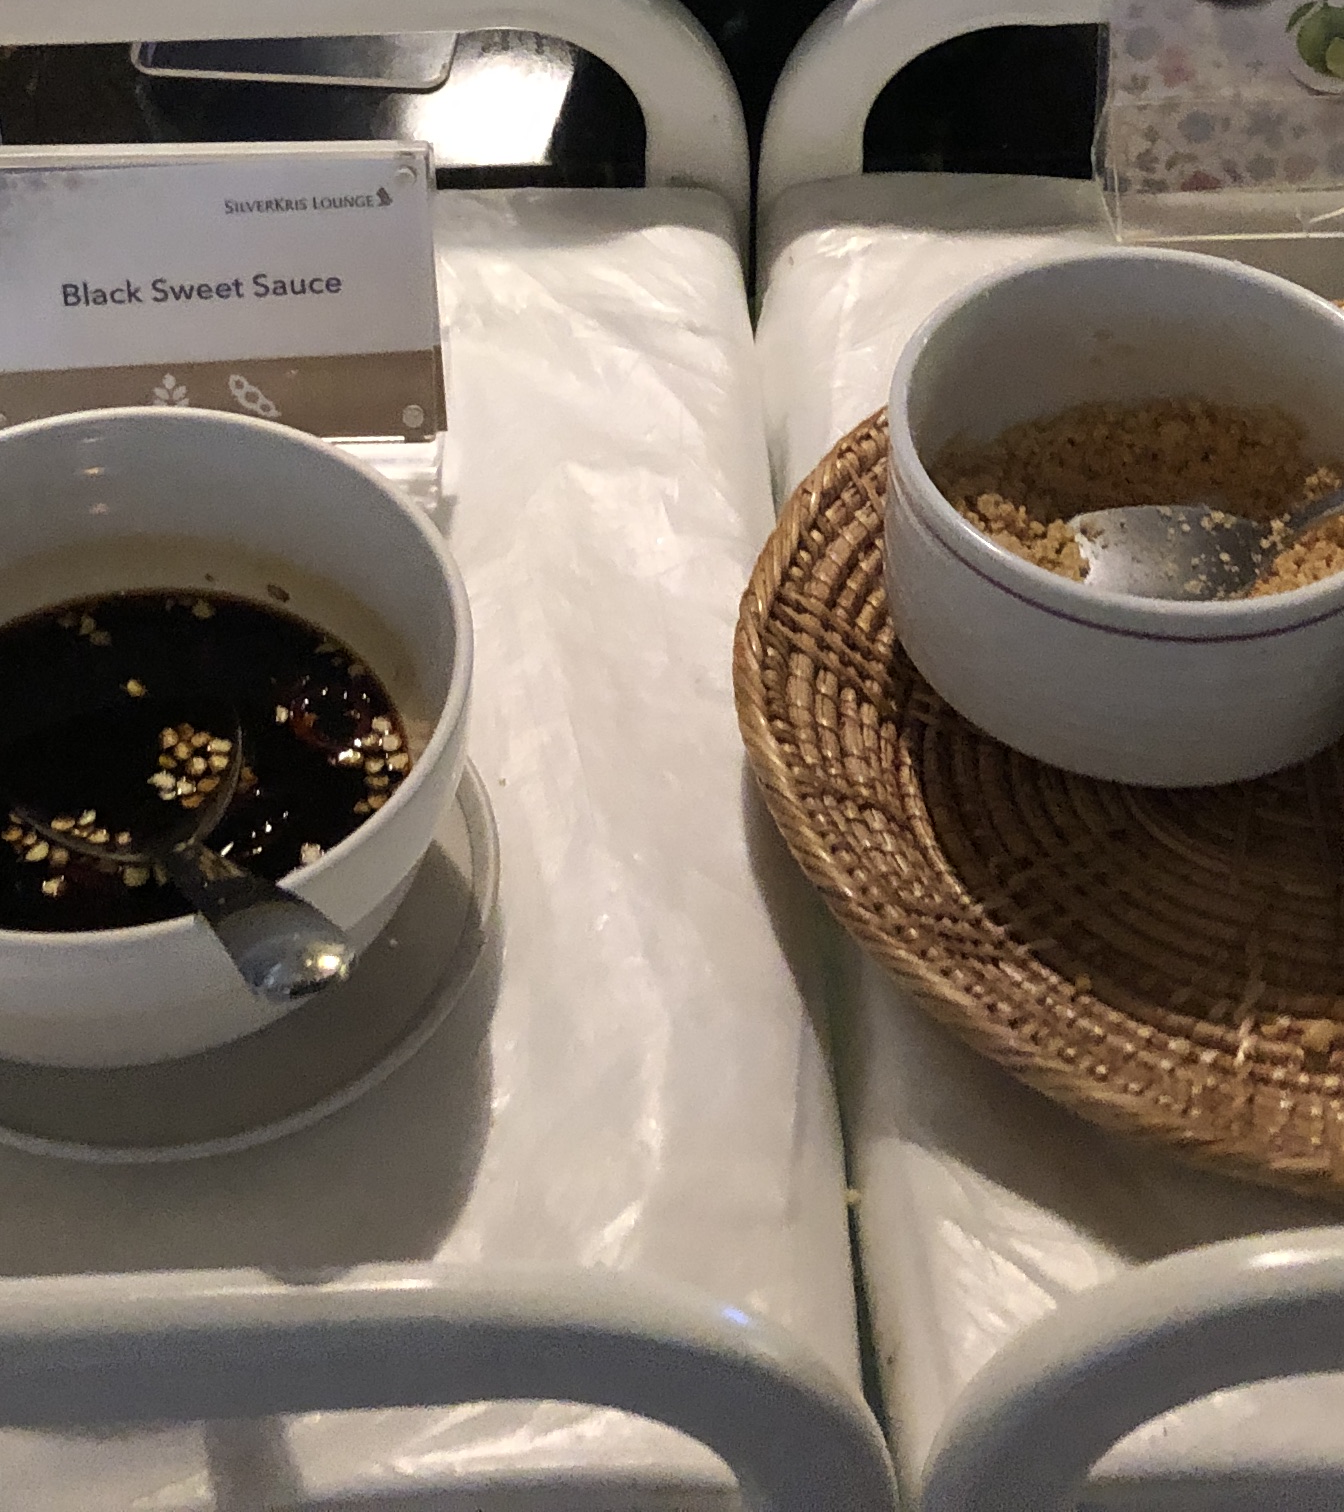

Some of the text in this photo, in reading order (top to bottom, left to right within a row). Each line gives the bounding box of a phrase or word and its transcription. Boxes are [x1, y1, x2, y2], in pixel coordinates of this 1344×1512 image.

[313, 193, 375, 210] LOUNGE
[62, 273, 343, 308] Black Sweet Sauce
